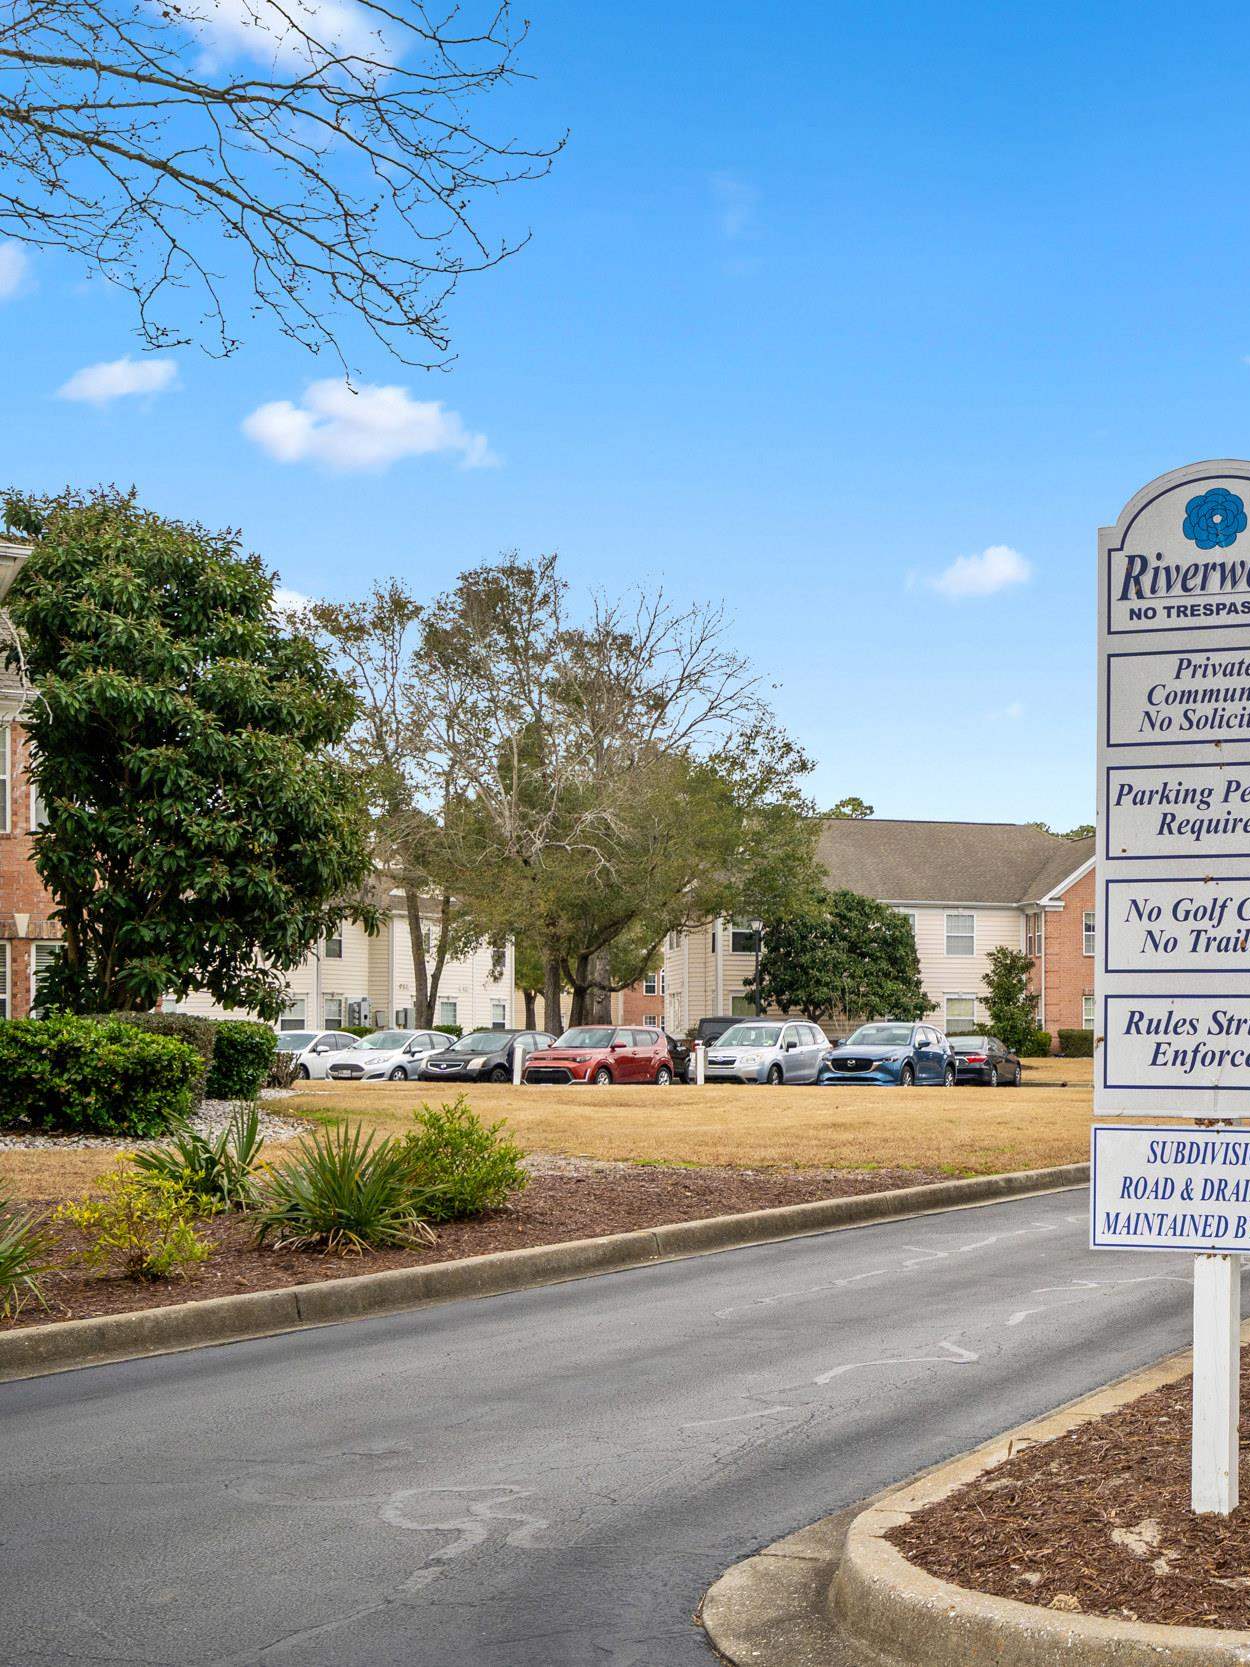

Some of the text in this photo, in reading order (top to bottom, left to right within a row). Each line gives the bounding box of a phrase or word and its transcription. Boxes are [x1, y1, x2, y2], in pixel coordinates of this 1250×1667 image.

[1128, 606, 1157, 621] NO
[1138, 710, 1173, 733] No
[1113, 781, 1214, 810] Parking
[1124, 899, 1162, 923] No
[1171, 897, 1233, 928] Golf
[1140, 929, 1178, 954] No
[1123, 1010, 1200, 1036] Rules
[1120, 1176, 1176, 1200] ROAD
[1180, 1177, 1194, 1201] &
[1101, 1211, 1230, 1238] MAINTAINED
